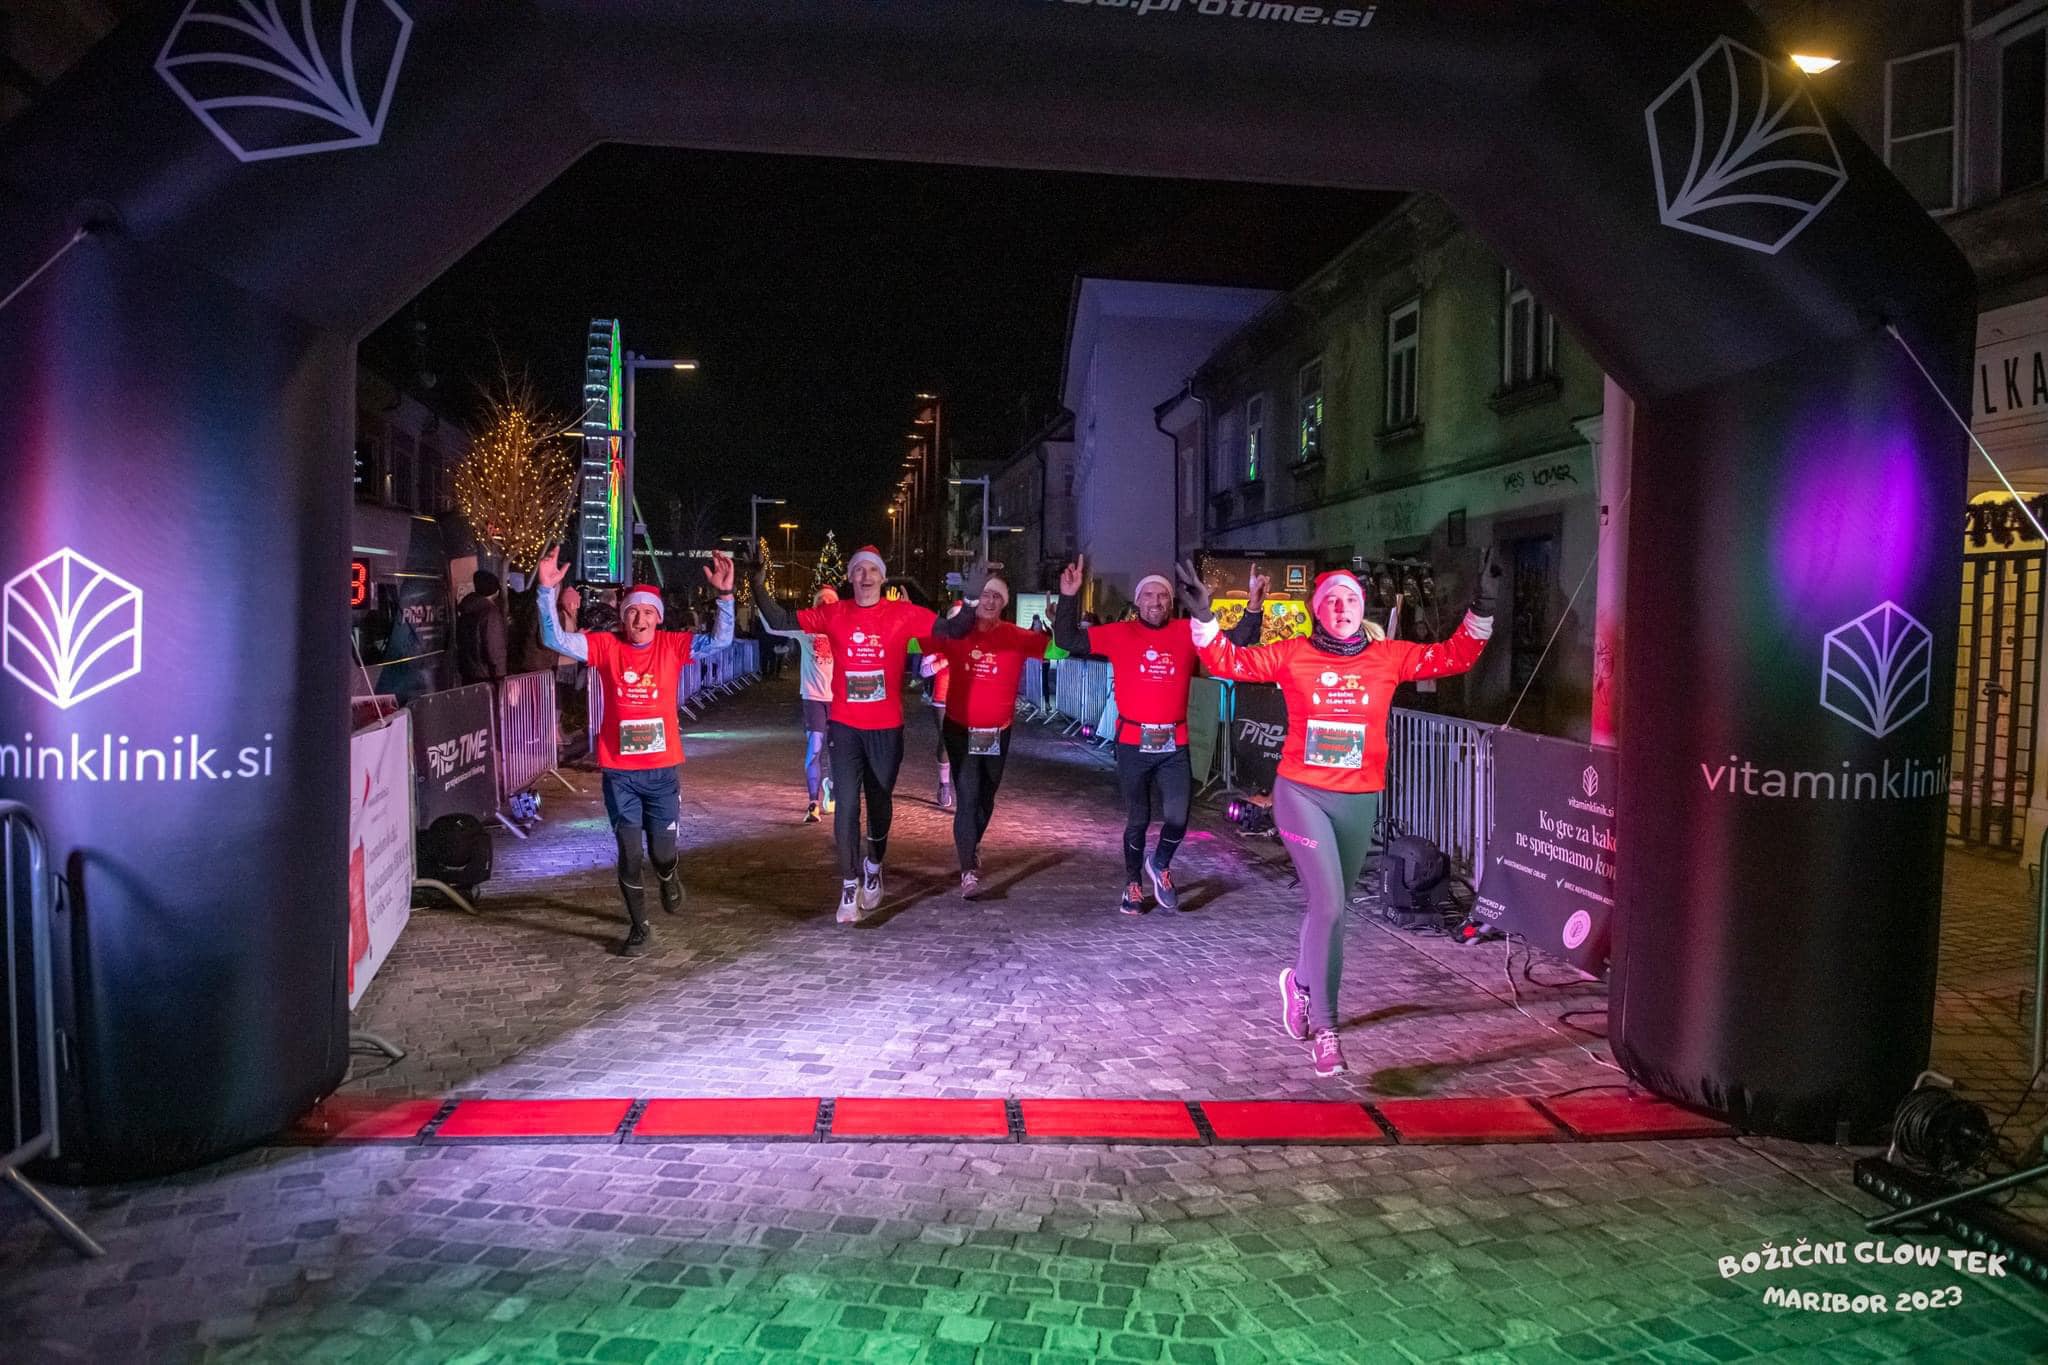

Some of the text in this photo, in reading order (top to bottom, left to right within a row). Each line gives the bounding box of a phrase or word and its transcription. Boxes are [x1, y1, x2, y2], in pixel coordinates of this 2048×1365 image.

[1539, 810, 1554, 833] Ko
[1556, 819, 1574, 840] gre
[1576, 826, 1590, 843] za
[1516, 832, 1528, 848] ne
[1529, 836, 1593, 872] sprejemamo
